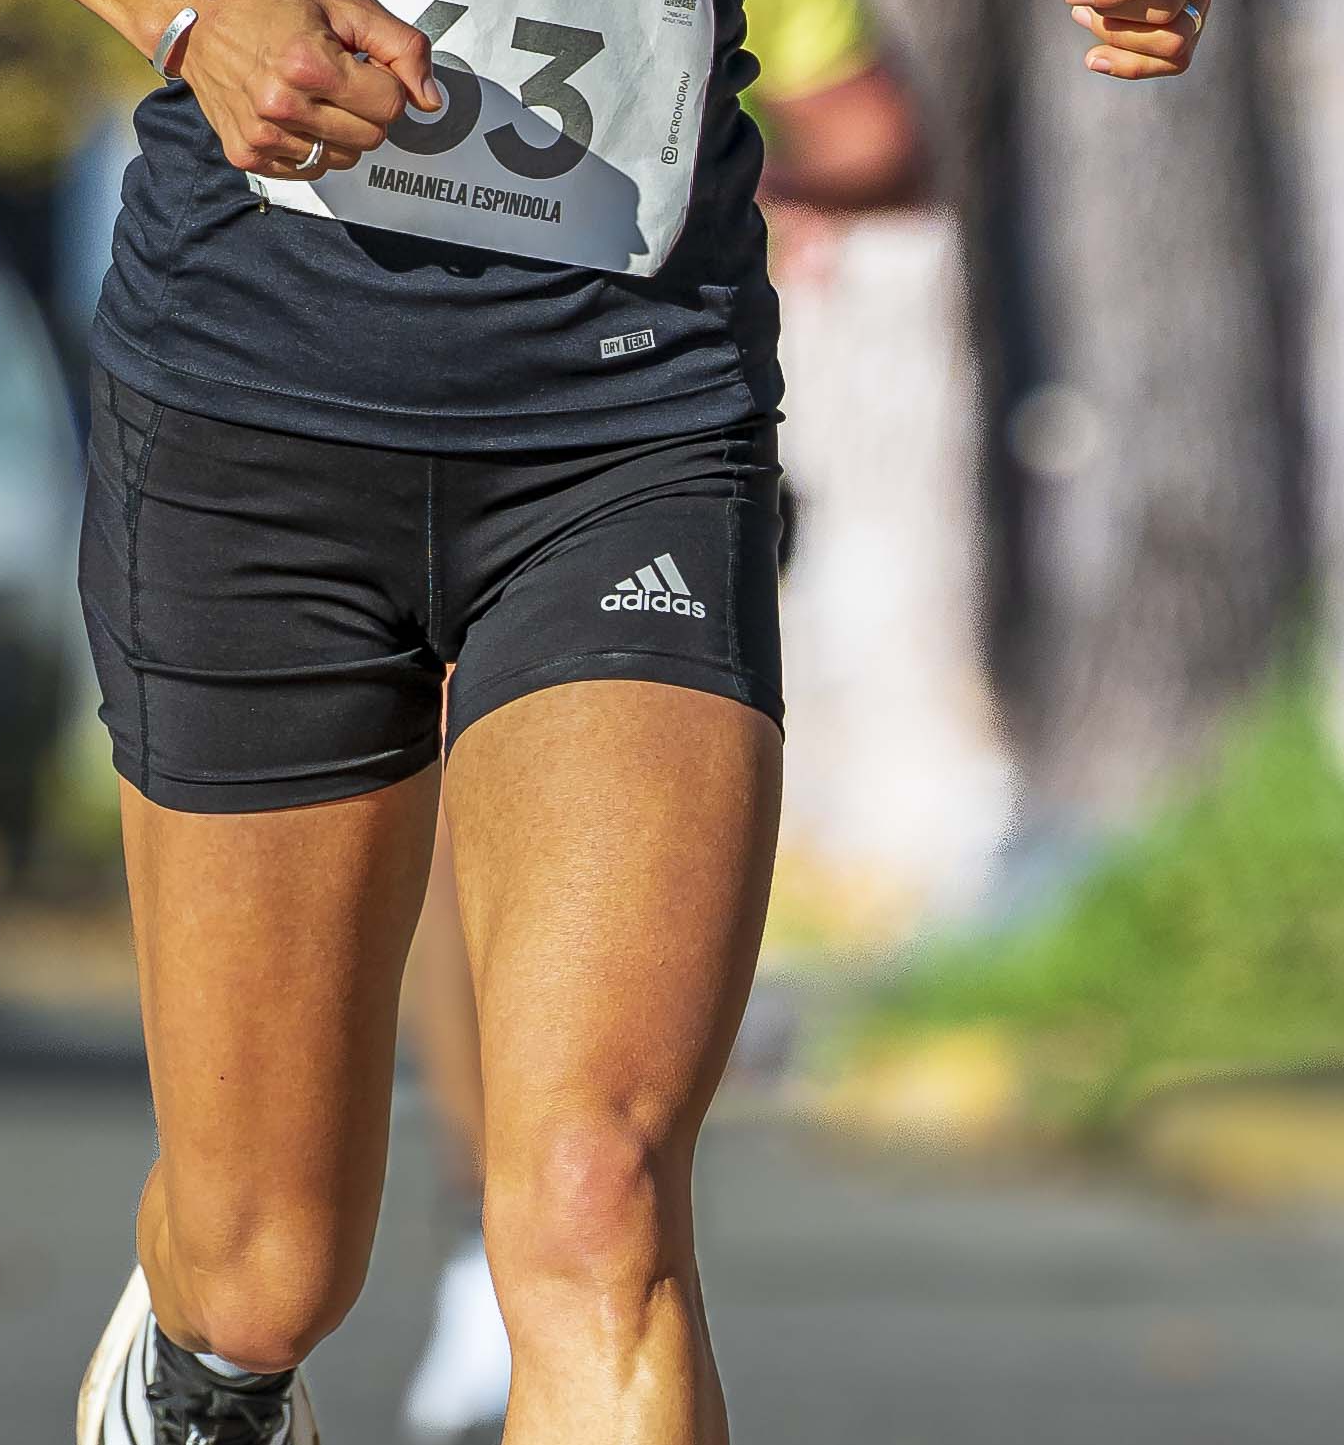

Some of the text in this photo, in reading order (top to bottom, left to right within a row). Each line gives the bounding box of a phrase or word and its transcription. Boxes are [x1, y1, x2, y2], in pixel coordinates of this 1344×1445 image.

[386, 0, 605, 180] 63
[668, 71, 690, 144] @CRONORAV
[368, 164, 562, 223] MARIANELA ESPINDOLA
[604, 334, 649, 354] DRY TECH
[600, 589, 706, 619] adidas
